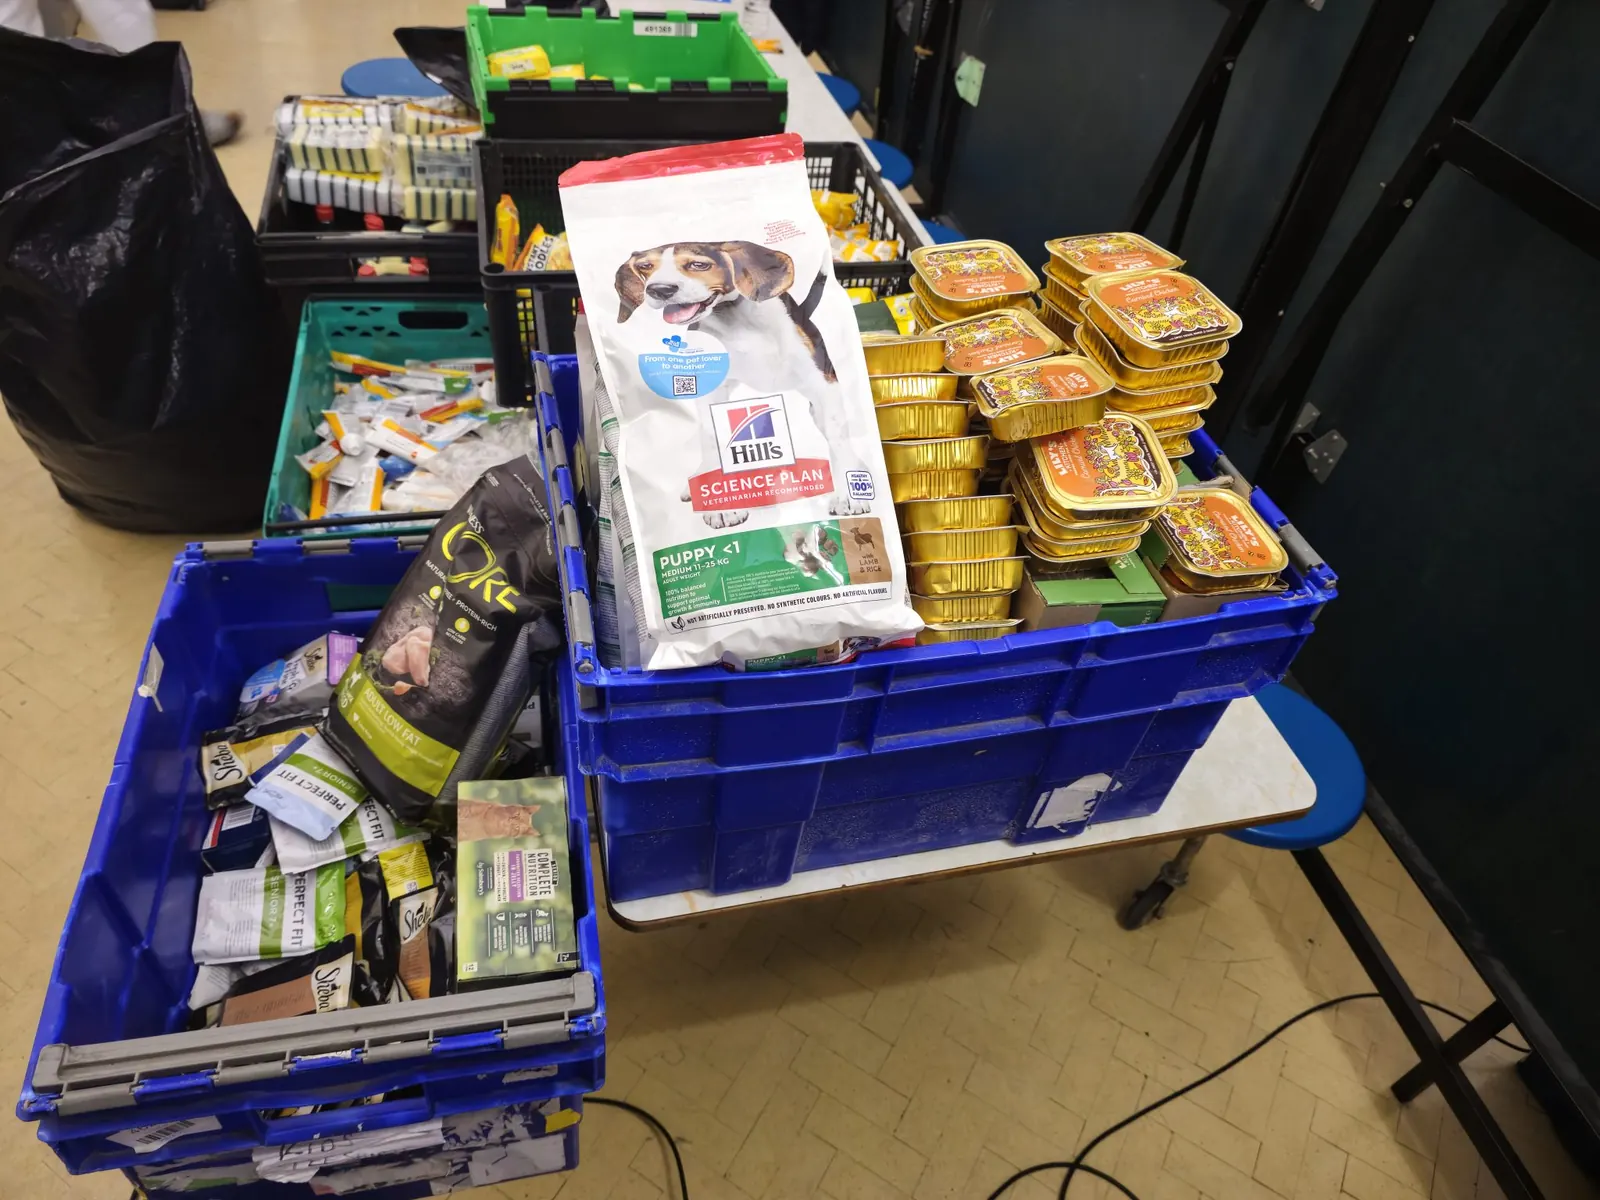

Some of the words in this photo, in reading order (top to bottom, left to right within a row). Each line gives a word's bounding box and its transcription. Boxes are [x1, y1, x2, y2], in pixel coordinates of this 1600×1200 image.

[535, 235, 554, 269] ODLES
[644, 355, 666, 363] From
[667, 356, 684, 364] one
[686, 355, 700, 365] pet
[672, 362, 706, 370] another
[983, 350, 1026, 366] LILY'S
[730, 441, 784, 465] Hill's
[1047, 439, 1069, 476] LILY'S
[700, 473, 776, 498] SCIENCE
[780, 468, 824, 486] PLAN
[702, 491, 763, 506] VETERINARIAN
[764, 483, 825, 497] RECOMMENDED
[850, 481, 873, 491] 100%
[1230, 514, 1260, 547] LILY'S
[660, 544, 716, 570] PUPPY
[722, 540, 741, 554] <1
[661, 565, 693, 579] MEDIUM
[717, 557, 730, 566] KG
[662, 576, 679, 585] ADULT
[679, 571, 701, 580] WEIGHT
[665, 588, 680, 596] 100%
[680, 582, 707, 593] balanced
[665, 593, 690, 603] nutrition
[667, 597, 688, 610] support
[688, 593, 711, 606] optimal
[667, 605, 688, 617] growth
[693, 599, 721, 609] immunity
[686, 617, 697, 625] NOT
[698, 610, 732, 622] ARTIFICIALLY
[776, 597, 806, 609] SYNTHETIC
[842, 589, 868, 598] ARTIFICIAL
[867, 587, 888, 595] FLAVOURS
[455, 599, 498, 632] PROTEIN-RICH
[364, 687, 385, 714] ADULT
[383, 710, 403, 732] LOW
[401, 728, 422, 746] FAT
[213, 744, 243, 781] Sheba
[276, 769, 301, 783] FIT
[293, 779, 348, 811] PERFECT
[324, 770, 358, 794] SENIOR
[363, 796, 380, 827] FECT
[371, 823, 385, 840] FIT
[476, 868, 485, 896] Sainsbury's
[527, 853, 539, 897] NUTRITION
[537, 852, 552, 896] COMPLETE
[269, 875, 281, 916] SENIOR
[292, 871, 307, 925] PERFECT
[291, 928, 303, 947] FIT
[315, 967, 341, 1010] Sheba
